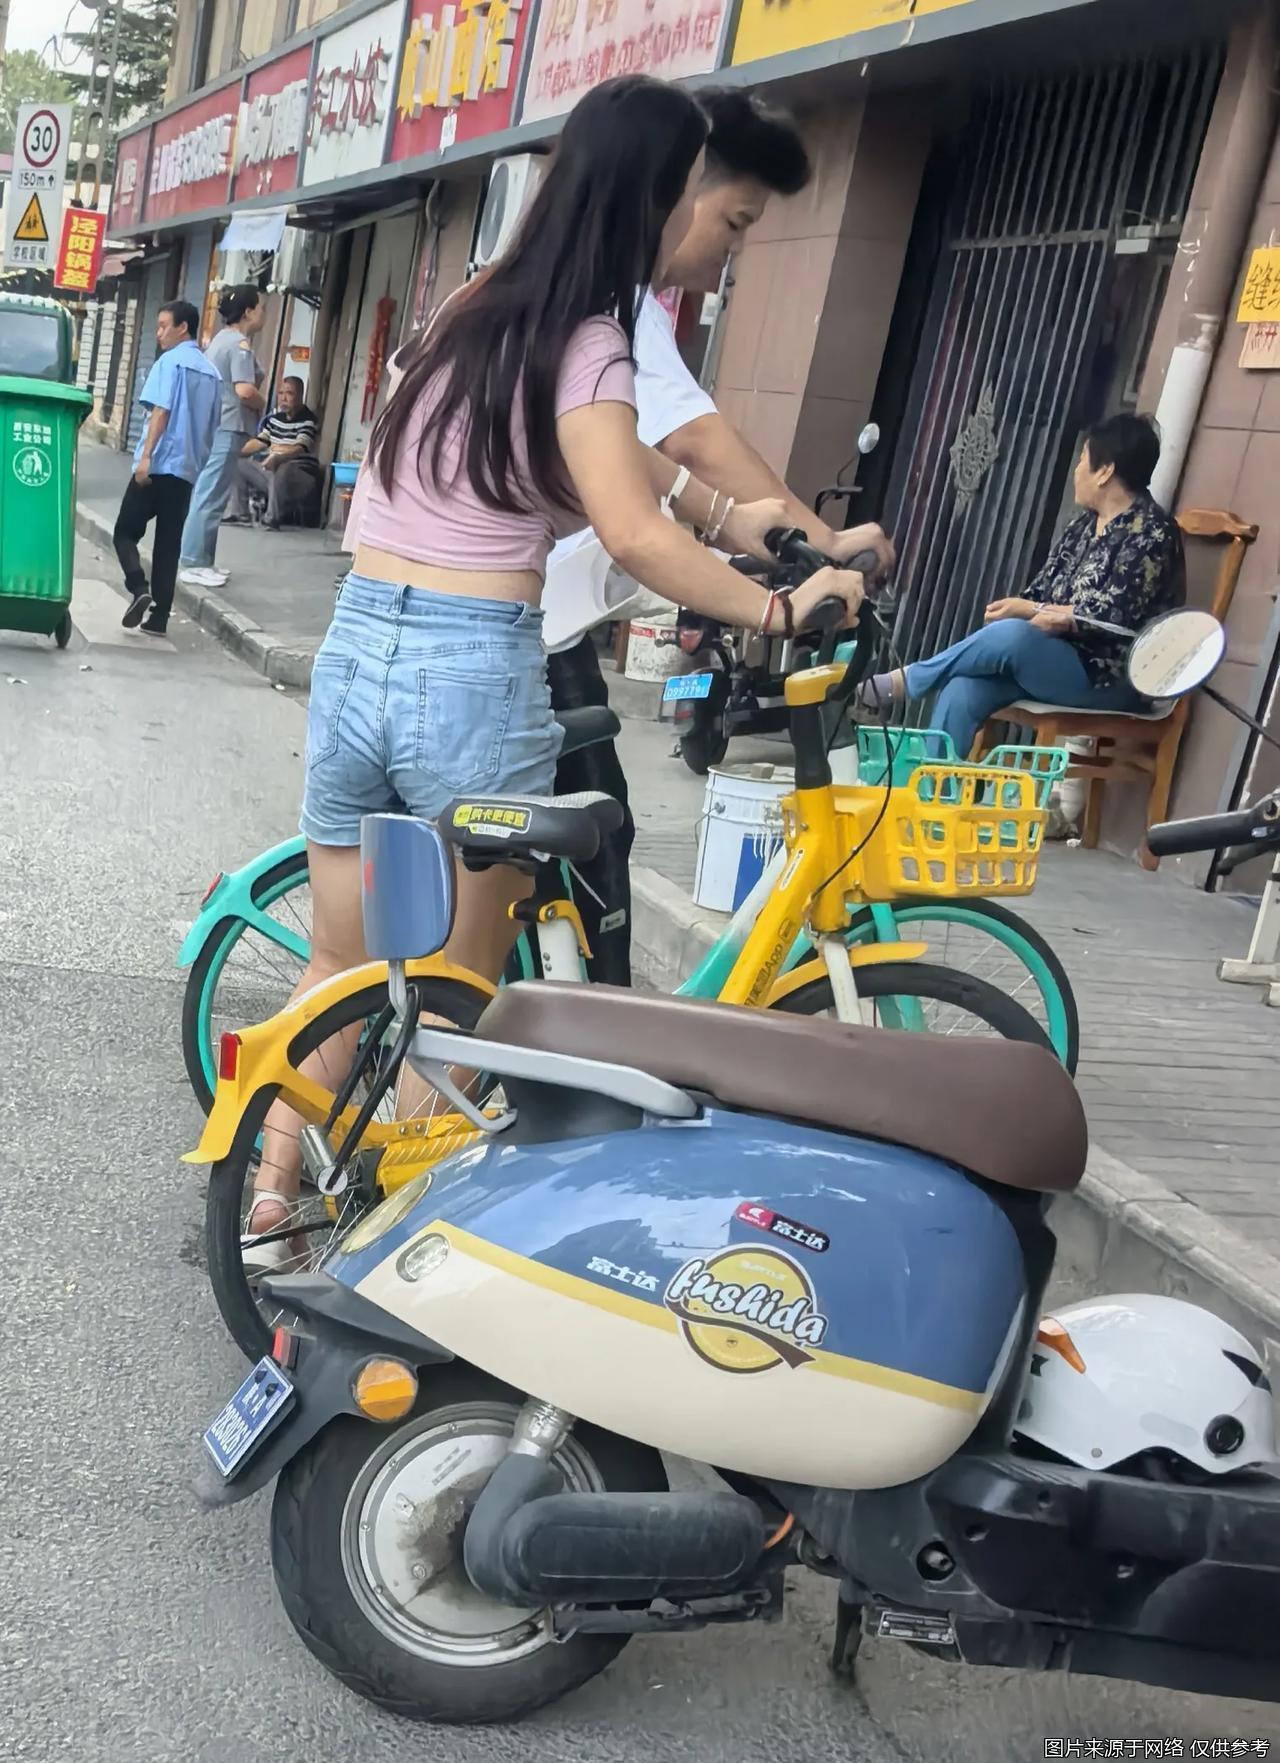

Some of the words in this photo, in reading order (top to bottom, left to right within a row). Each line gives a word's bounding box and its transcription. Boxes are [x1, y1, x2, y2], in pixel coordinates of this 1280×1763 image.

[31, 127, 53, 152] 30
[20, 173, 46, 187] 150m
[13, 246, 46, 261] 学校区域
[771, 1219, 827, 1251] 富士达
[586, 1256, 660, 1293] 富士达
